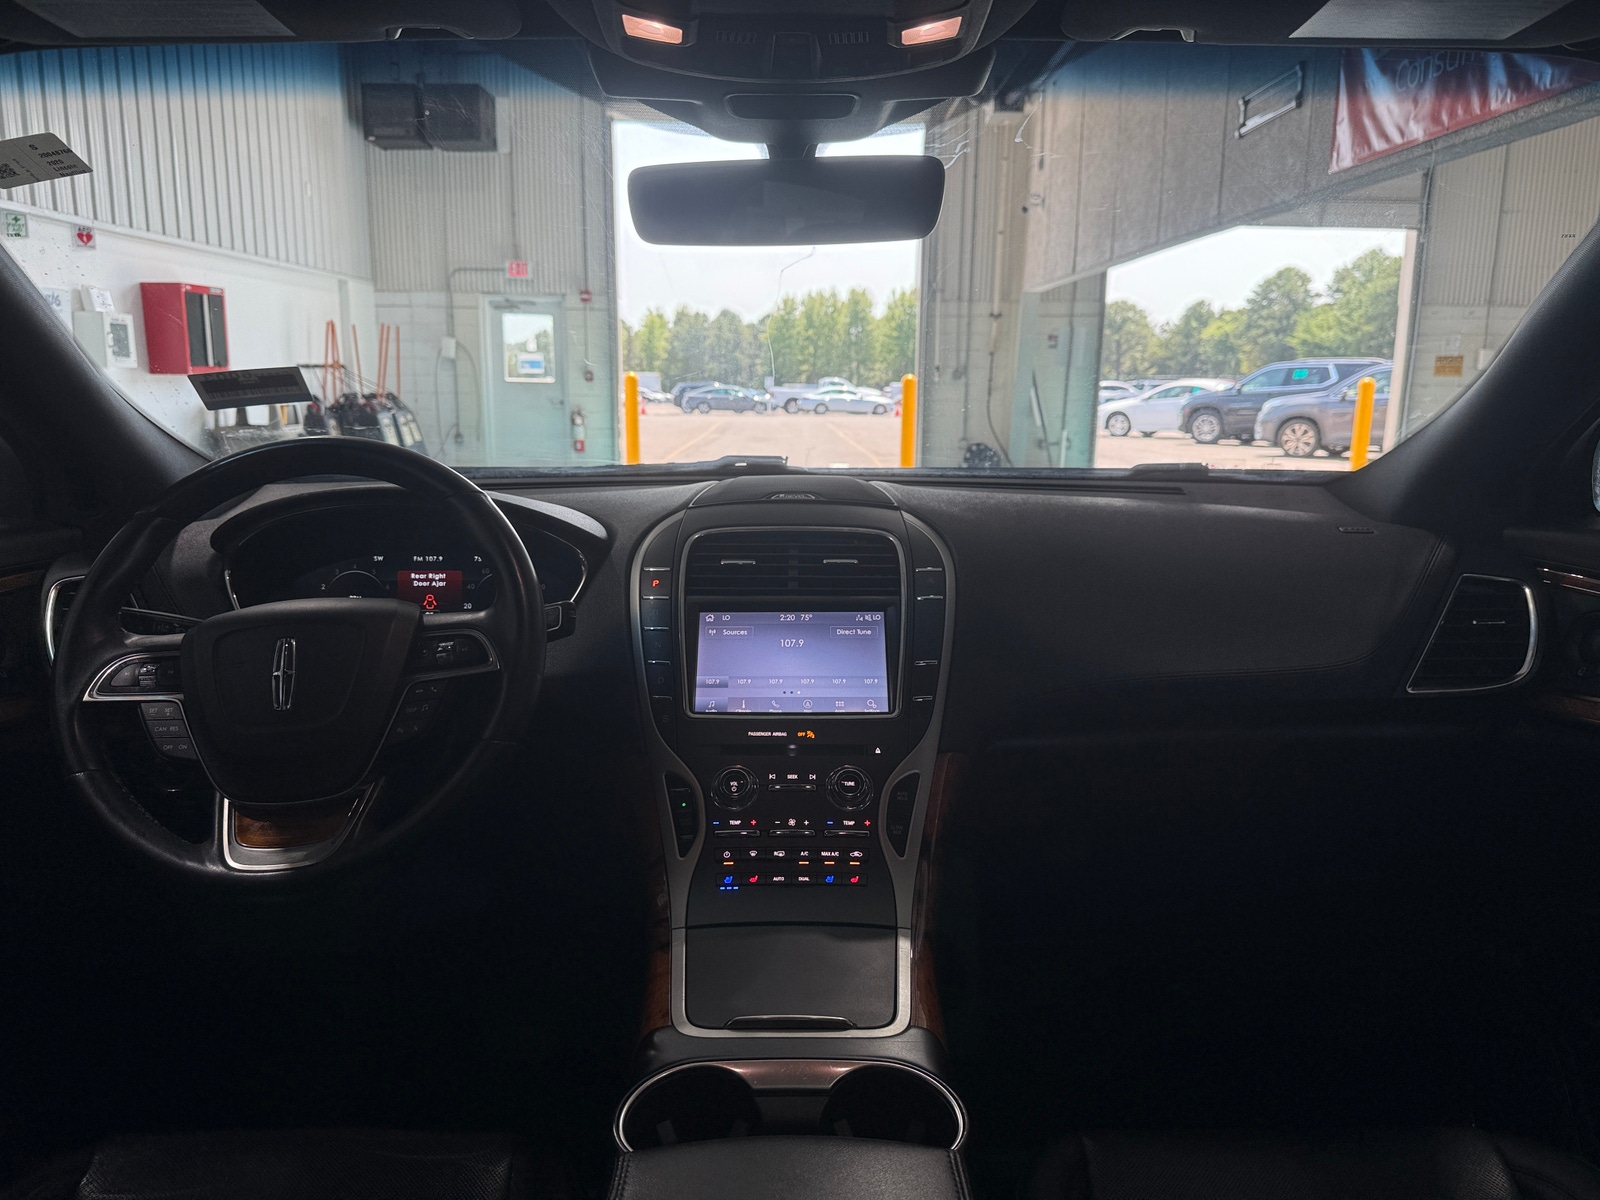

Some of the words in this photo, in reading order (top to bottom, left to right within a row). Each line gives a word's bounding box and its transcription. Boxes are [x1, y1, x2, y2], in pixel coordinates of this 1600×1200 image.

[410, 572, 427, 580] Rear
[428, 572, 446, 581] Right
[652, 579, 660, 587] P
[800, 613, 813, 621] 75°
[722, 628, 748, 636] Sources
[780, 639, 804, 648] 107.9
